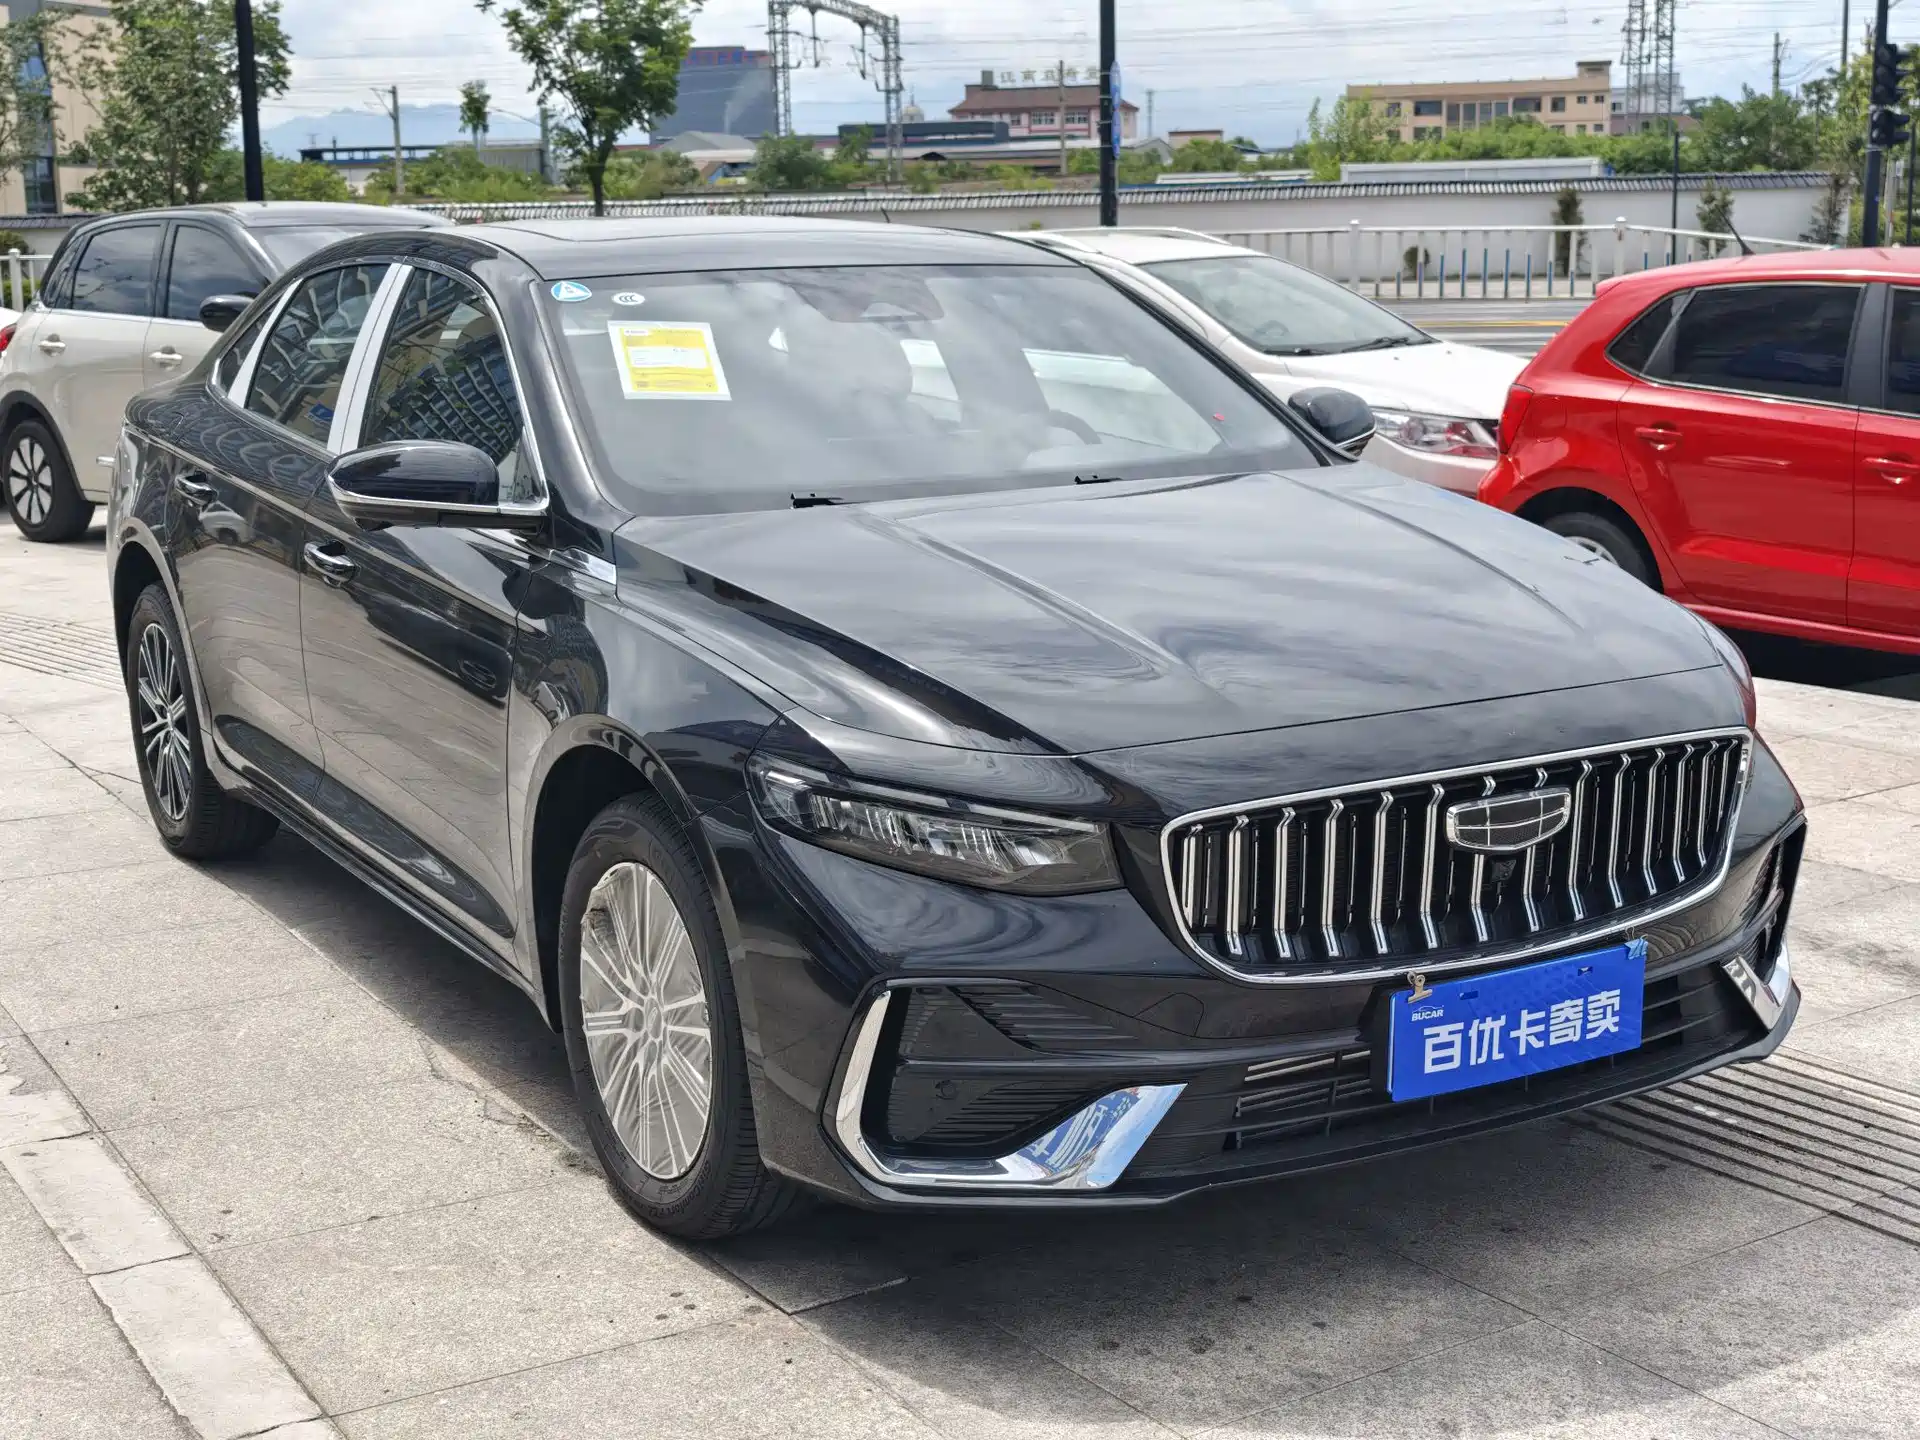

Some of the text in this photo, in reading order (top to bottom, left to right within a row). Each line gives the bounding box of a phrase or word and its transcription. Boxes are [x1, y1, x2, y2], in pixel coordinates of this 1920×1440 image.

[1411, 1009, 1444, 1022] BUCAR
[1423, 989, 1621, 1074] 百优卡寄卖
